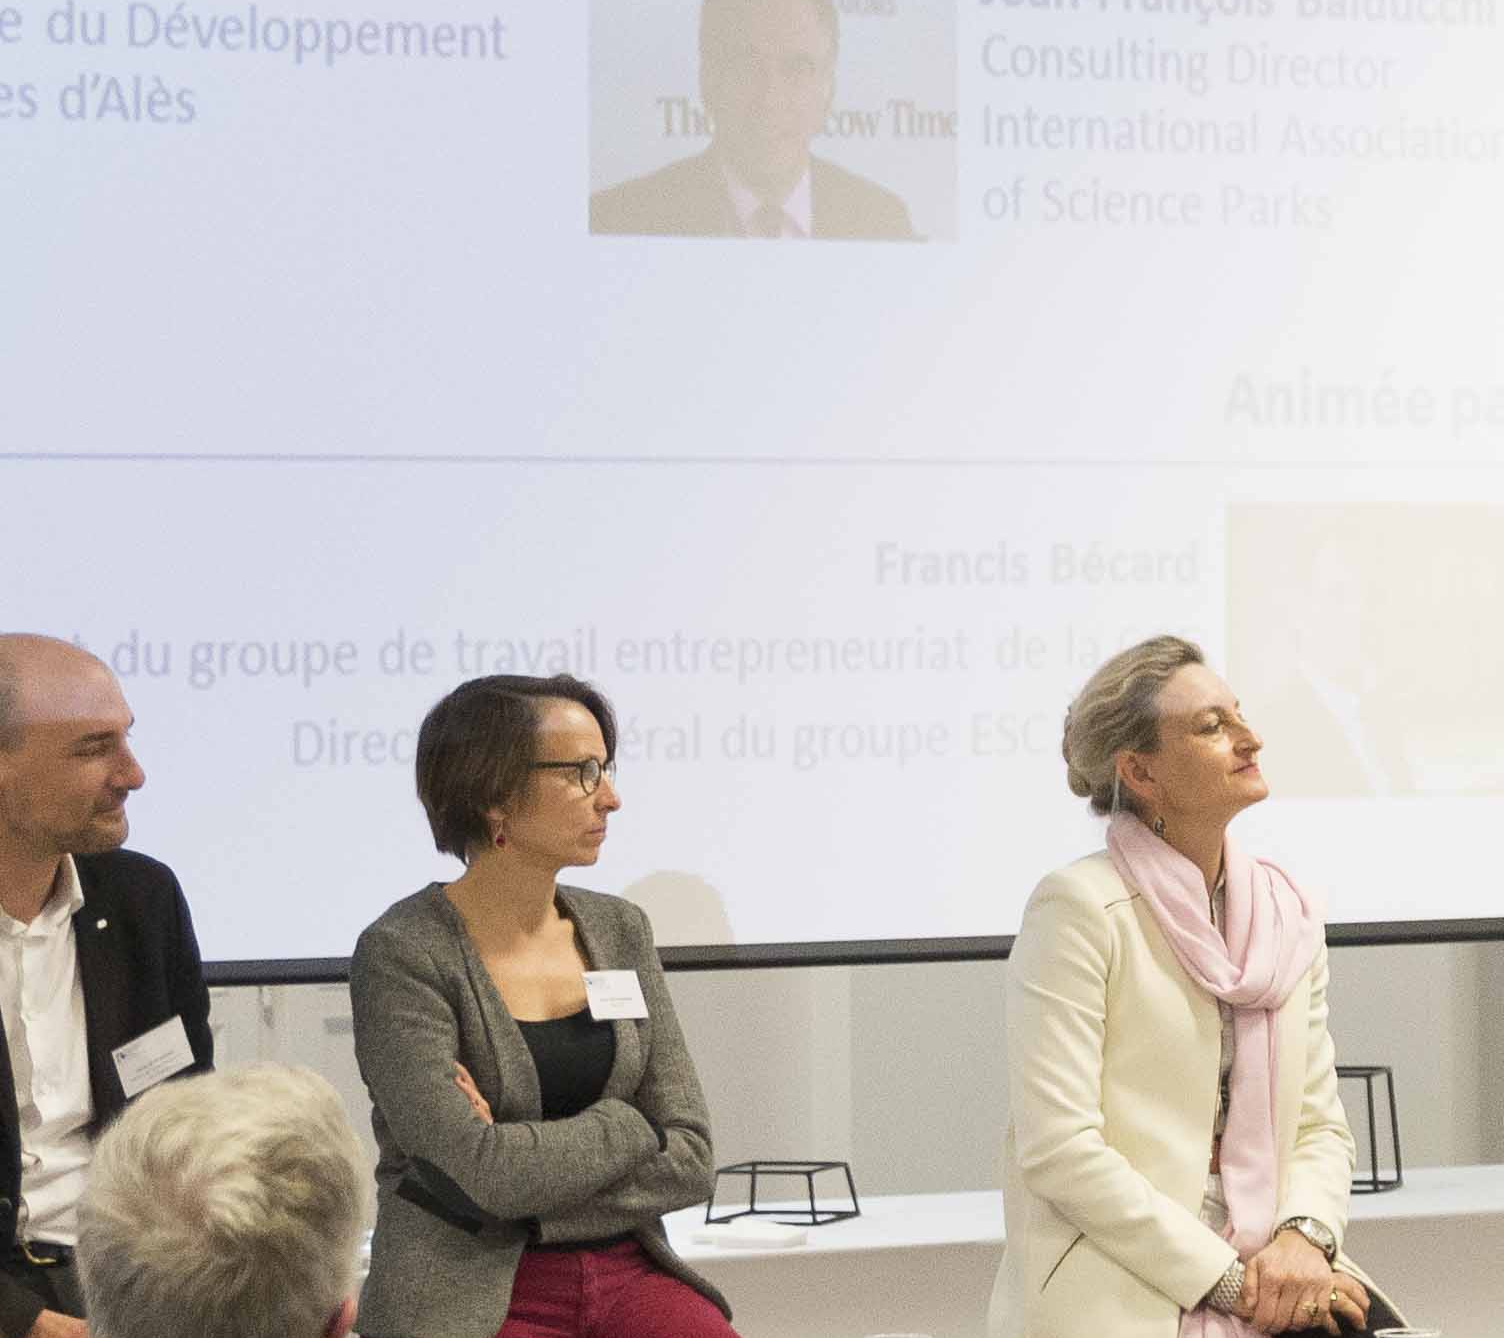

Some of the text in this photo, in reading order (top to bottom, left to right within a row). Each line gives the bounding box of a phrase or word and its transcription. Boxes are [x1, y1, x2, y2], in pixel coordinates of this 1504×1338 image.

[127, 2, 506, 67] Développement
[981, 34, 1394, 96] Consulting Director
[982, 104, 1258, 154] International
[982, 175, 1332, 230] of Science Parks
[1223, 366, 1436, 427] Animée
[875, 540, 1028, 585] Francis
[110, 629, 174, 679] du
[188, 641, 358, 690] groupe
[378, 629, 436, 677] de
[456, 628, 600, 677] travail
[614, 625, 968, 685] entrepreneuriat
[720, 713, 776, 760] du
[792, 722, 950, 772] groupe
